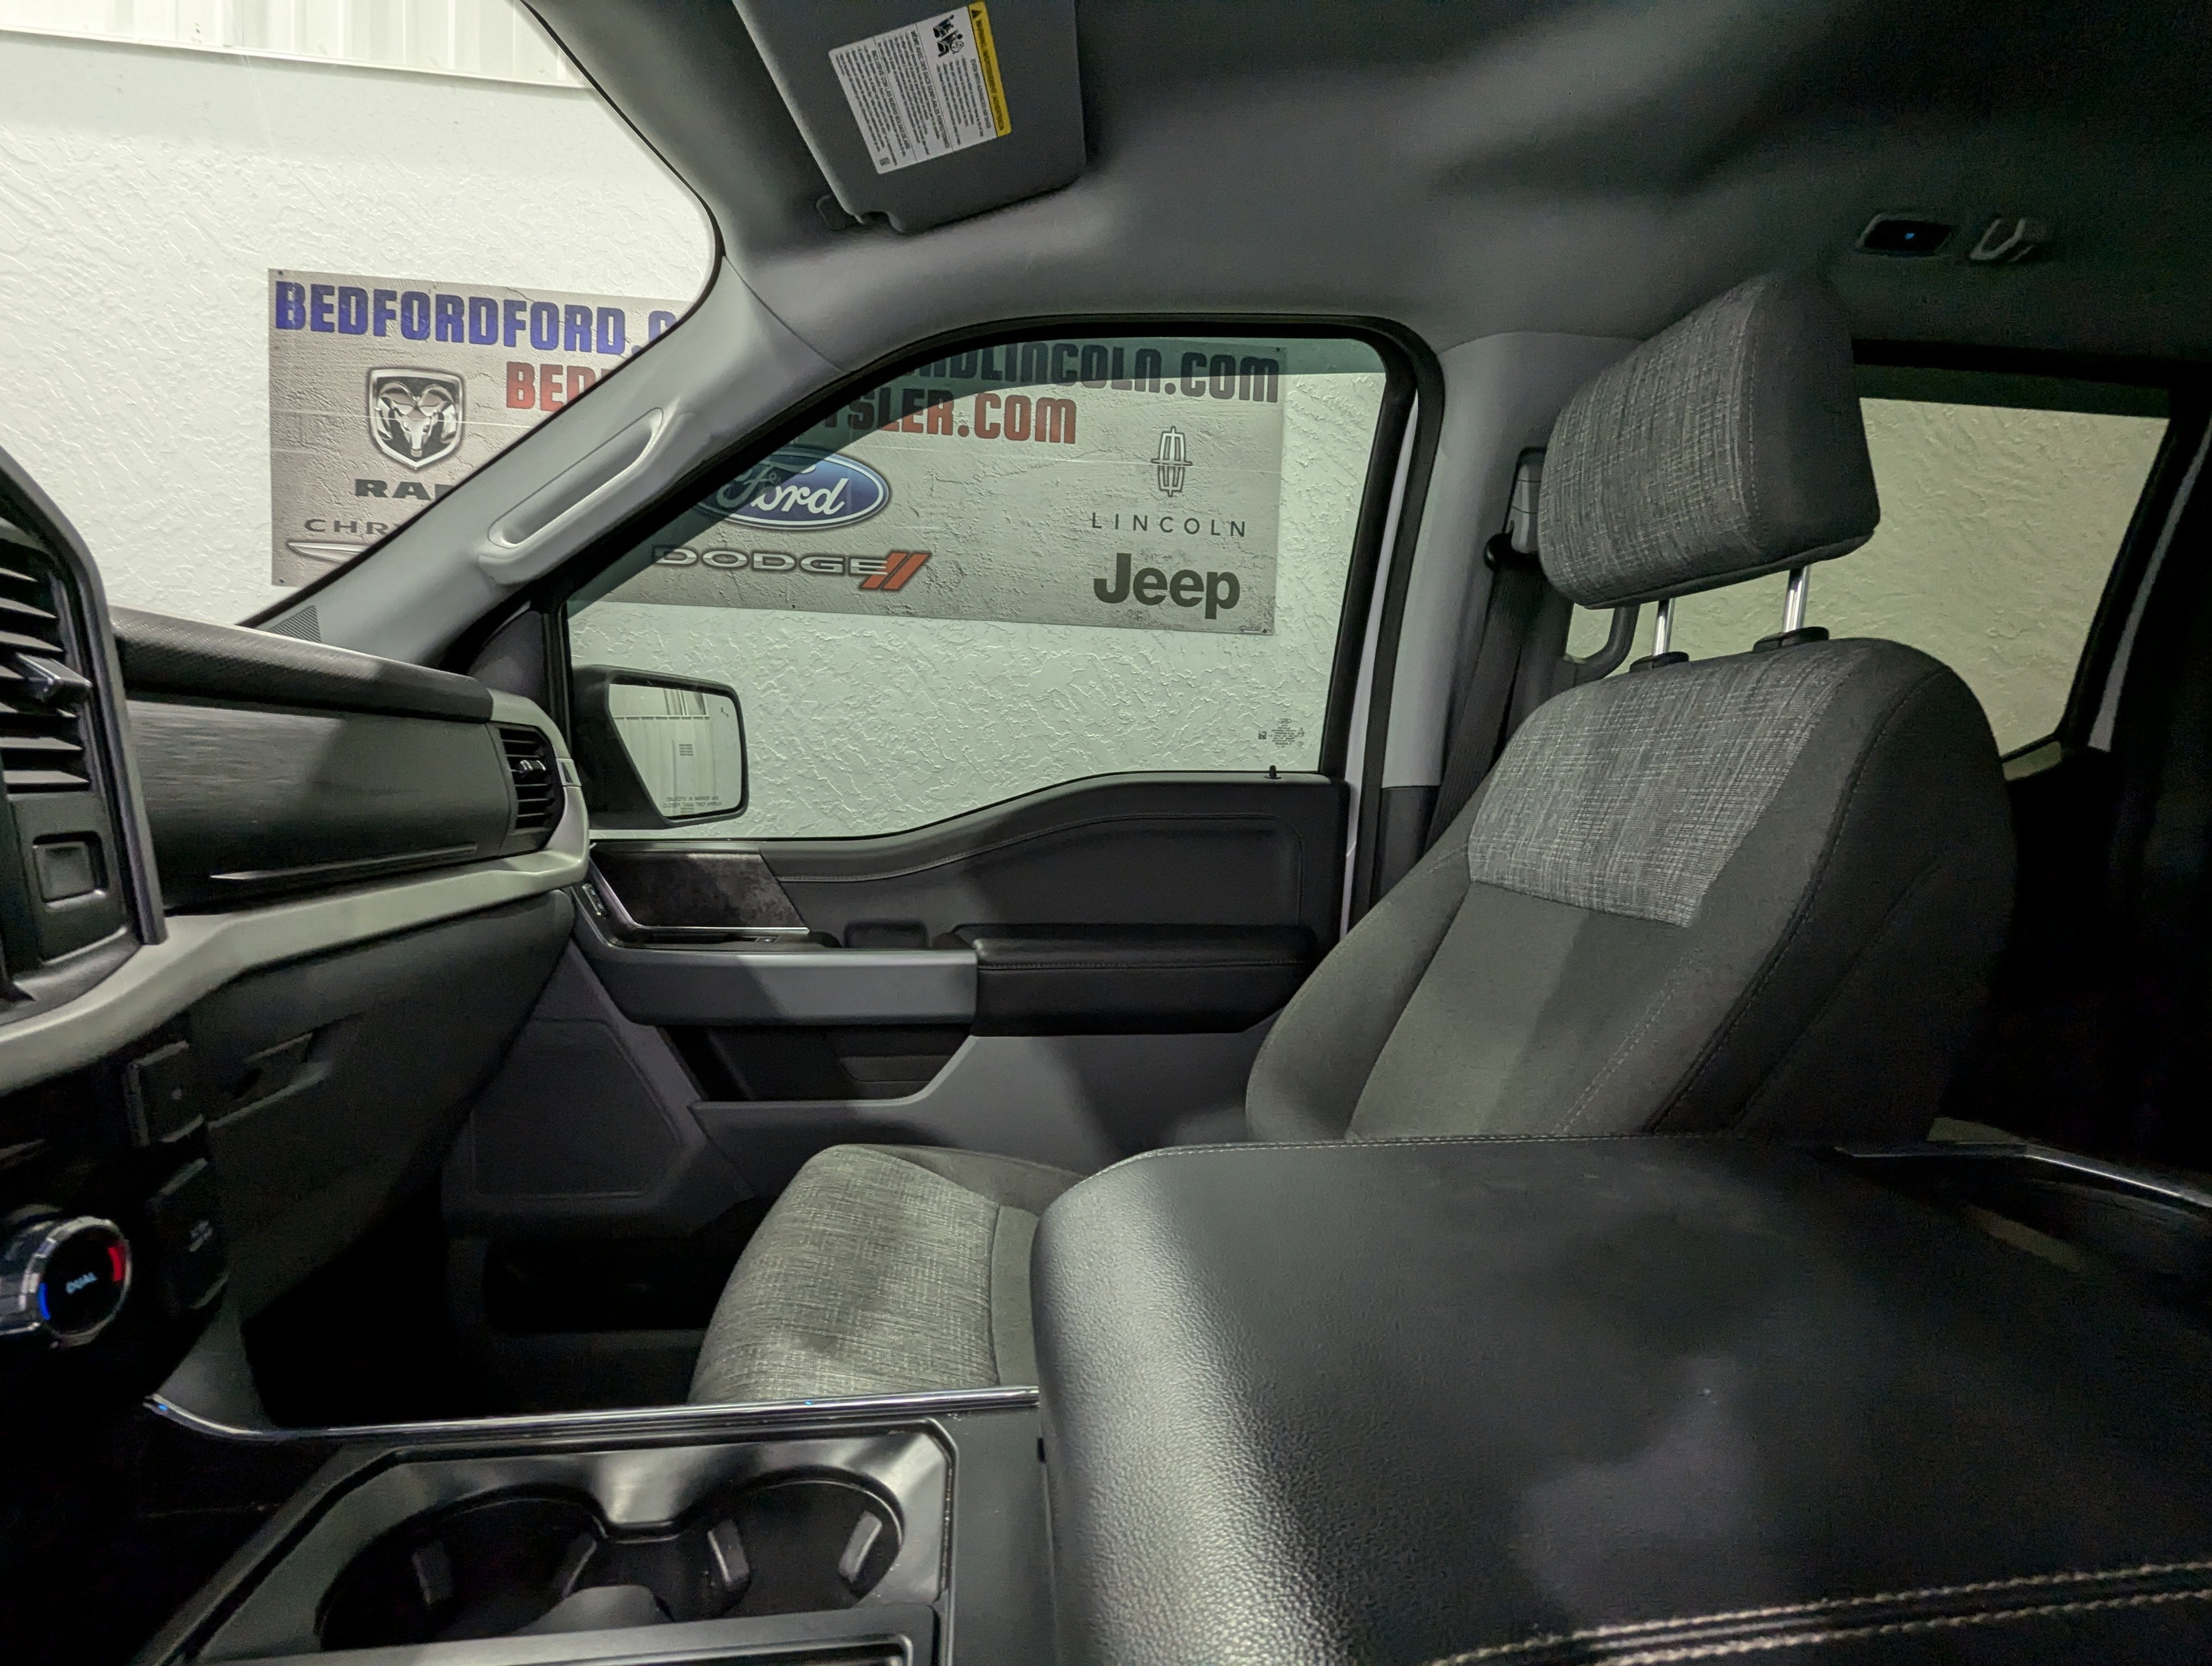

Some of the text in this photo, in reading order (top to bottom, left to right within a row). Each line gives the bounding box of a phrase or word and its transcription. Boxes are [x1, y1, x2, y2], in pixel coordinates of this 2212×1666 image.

[507, 361, 610, 412] BED
[716, 461, 849, 515] Ford
[304, 518, 401, 536] CHR
[1092, 512, 1245, 537] LINCOLN
[654, 546, 889, 576] DODGE
[1094, 553, 1240, 619] Jeep
